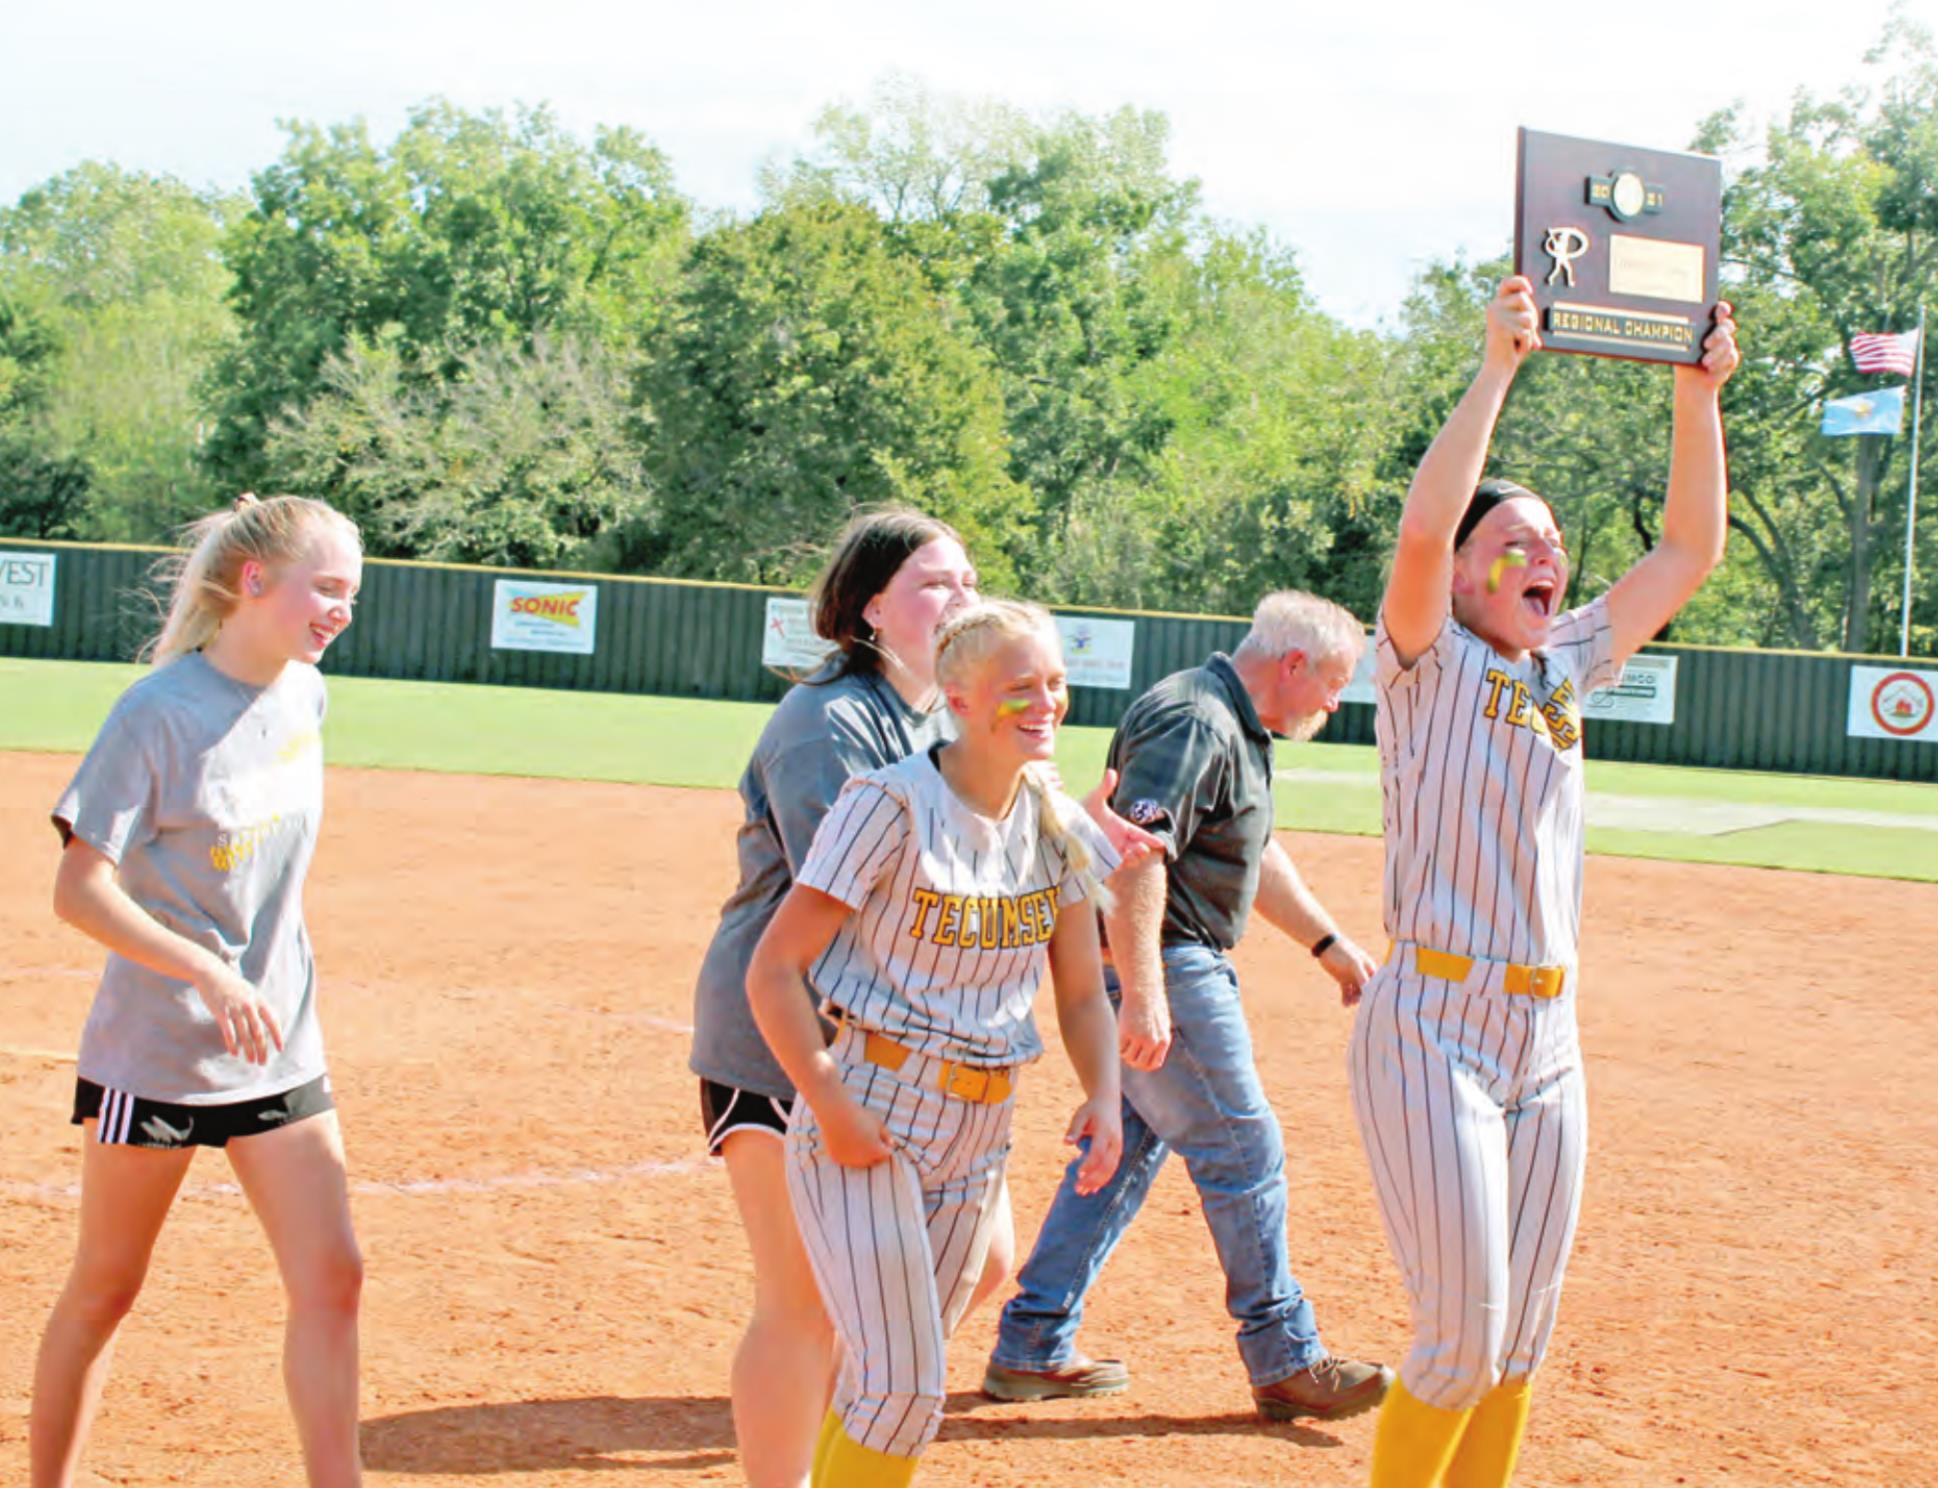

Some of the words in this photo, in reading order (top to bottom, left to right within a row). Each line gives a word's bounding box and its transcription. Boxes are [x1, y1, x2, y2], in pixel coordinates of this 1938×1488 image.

[1552, 311, 1620, 335] REGIONAL
[1625, 319, 1693, 344] CHAMPION
[510, 595, 580, 617] SONIC
